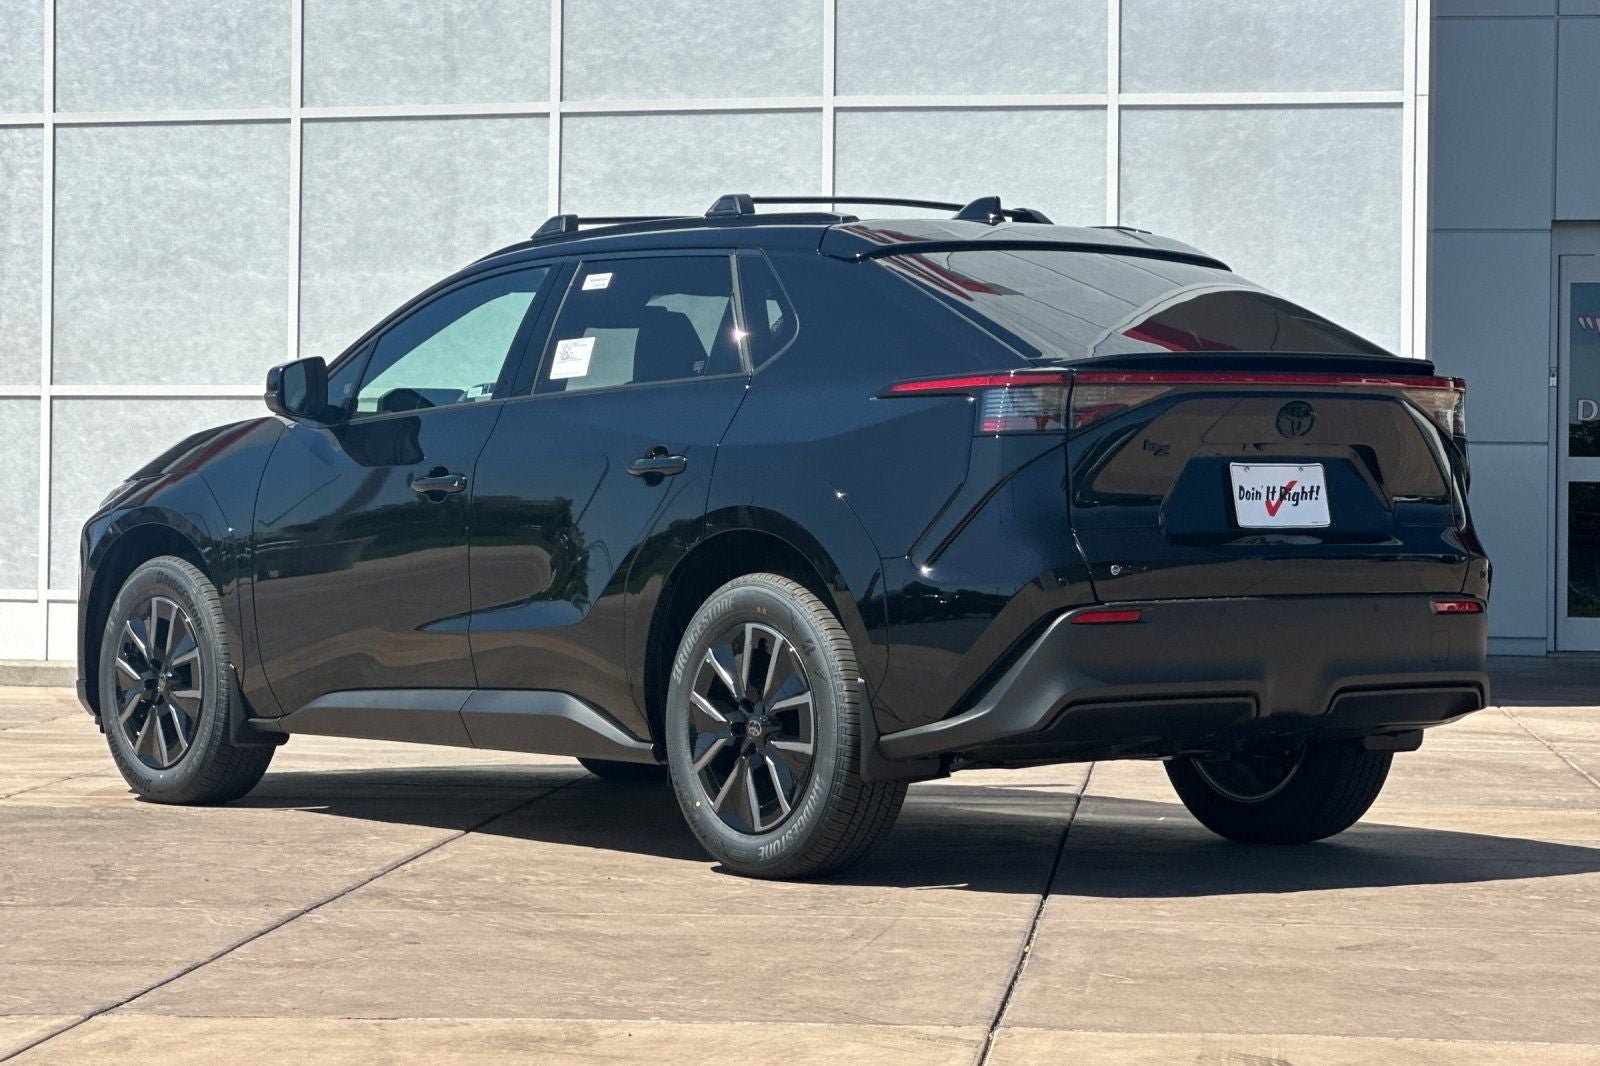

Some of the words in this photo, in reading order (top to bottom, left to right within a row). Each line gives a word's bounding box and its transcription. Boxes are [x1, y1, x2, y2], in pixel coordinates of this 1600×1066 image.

[1238, 485, 1264, 501] Doin'
[1266, 486, 1277, 501] It
[1280, 485, 1321, 507] Right!
[672, 595, 736, 685] BRIDGESTONE
[758, 774, 825, 861] BRIDGESTONE
